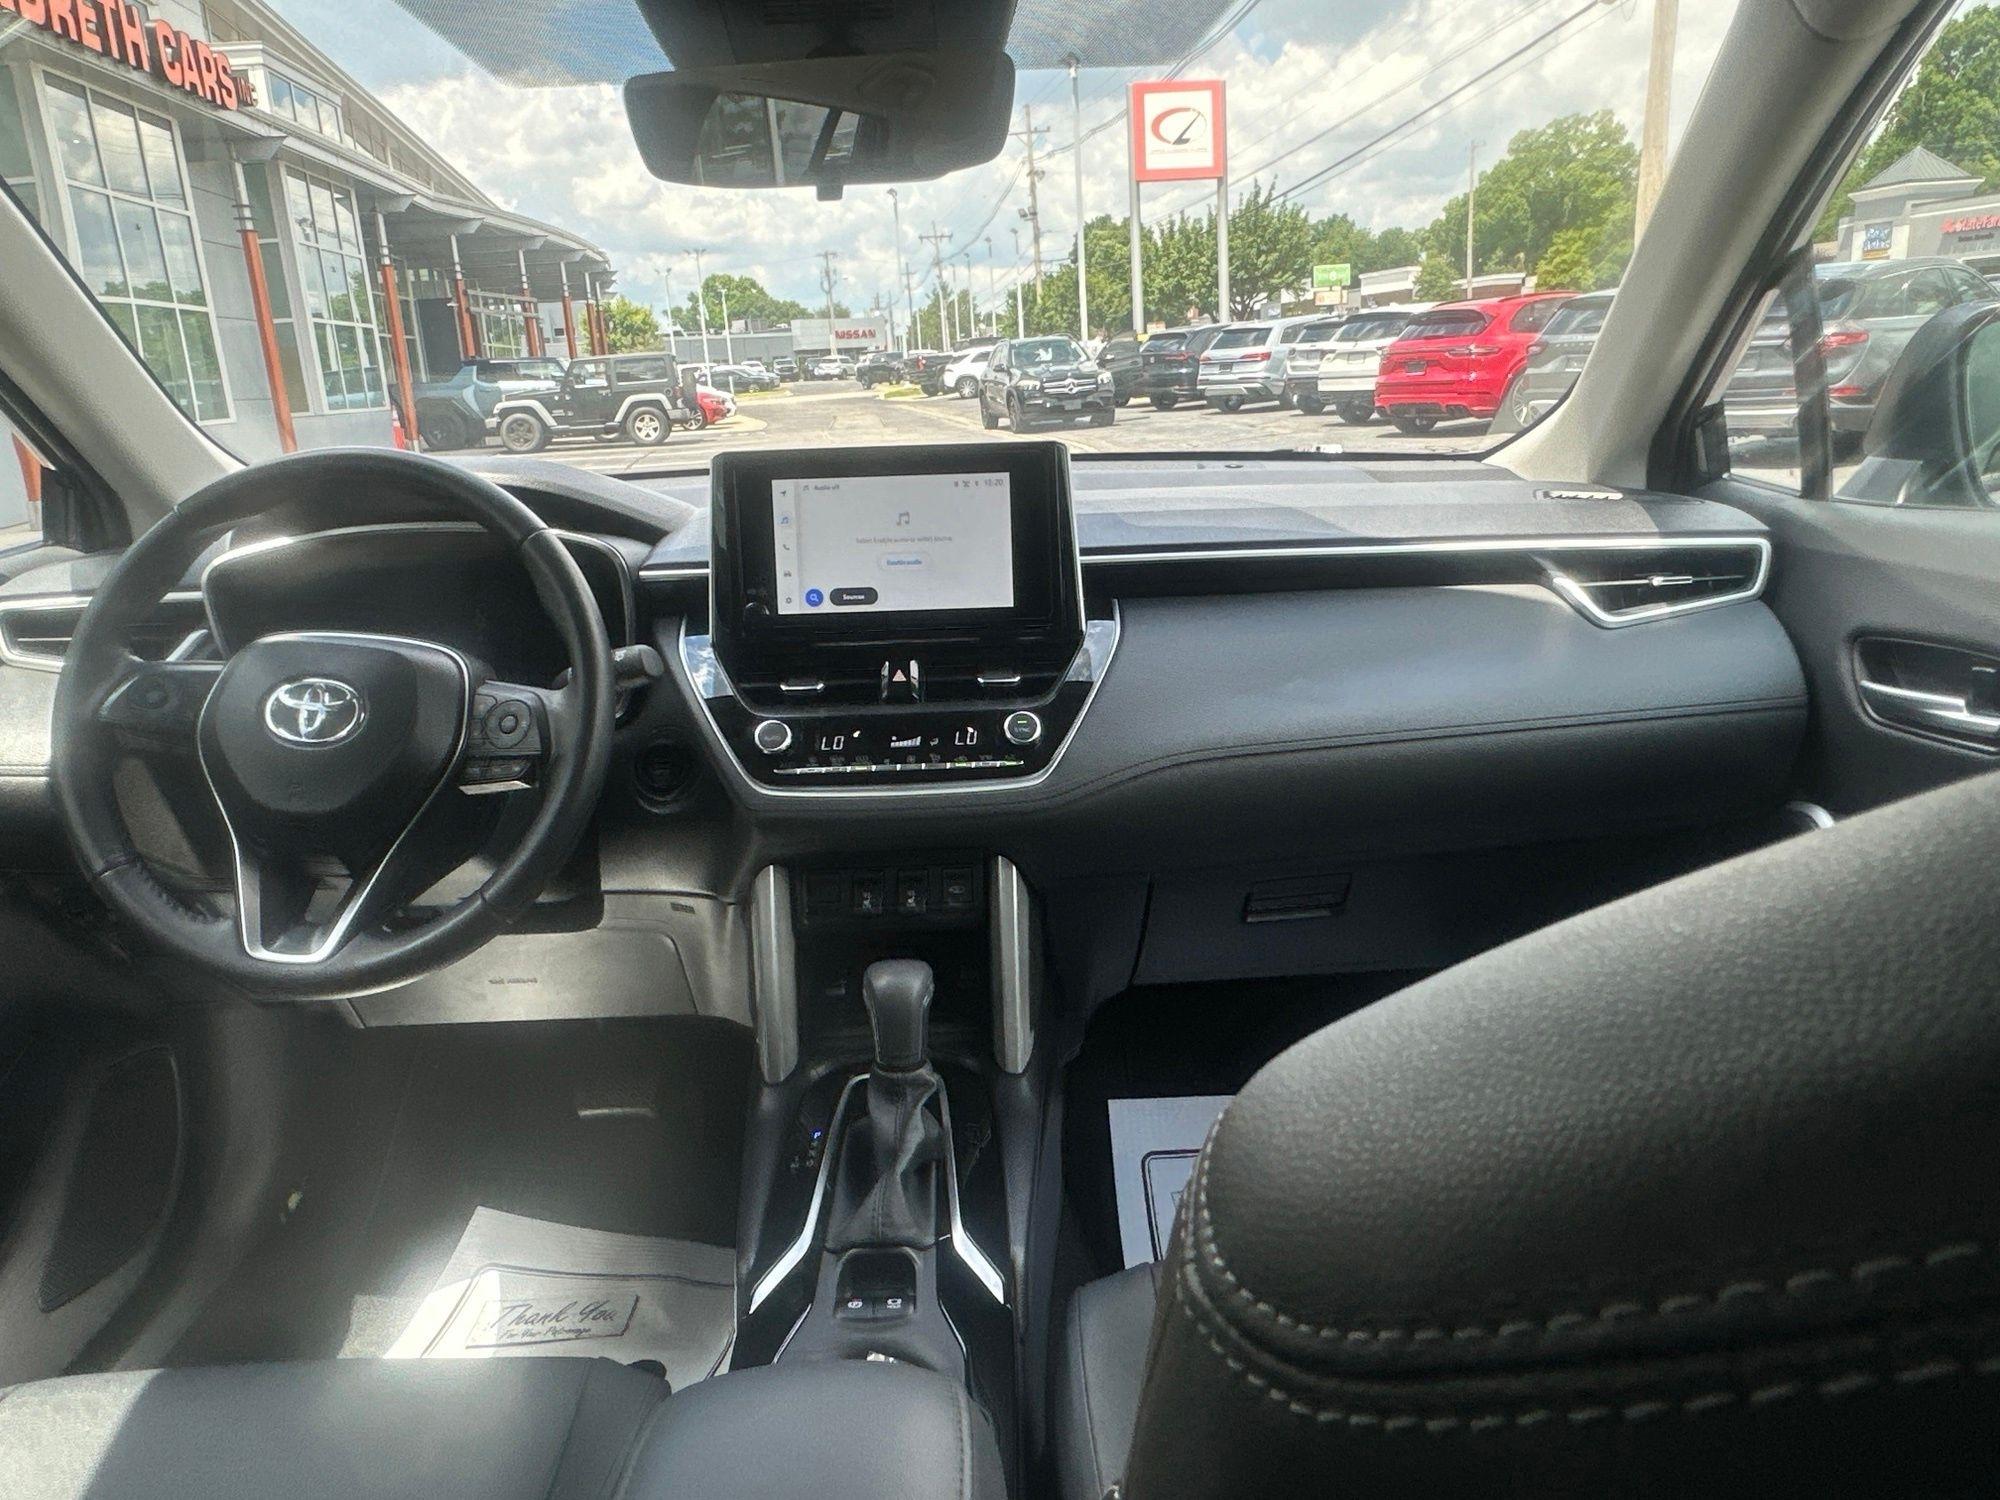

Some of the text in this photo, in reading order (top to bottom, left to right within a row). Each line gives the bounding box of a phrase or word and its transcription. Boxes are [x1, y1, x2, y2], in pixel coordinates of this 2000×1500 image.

[0, 0, 150, 72] RETH
[153, 19, 238, 110] CARS
[835, 329, 876, 339] NISSAN
[821, 735, 844, 750] LO
[490, 1299, 618, 1329] Thank You
